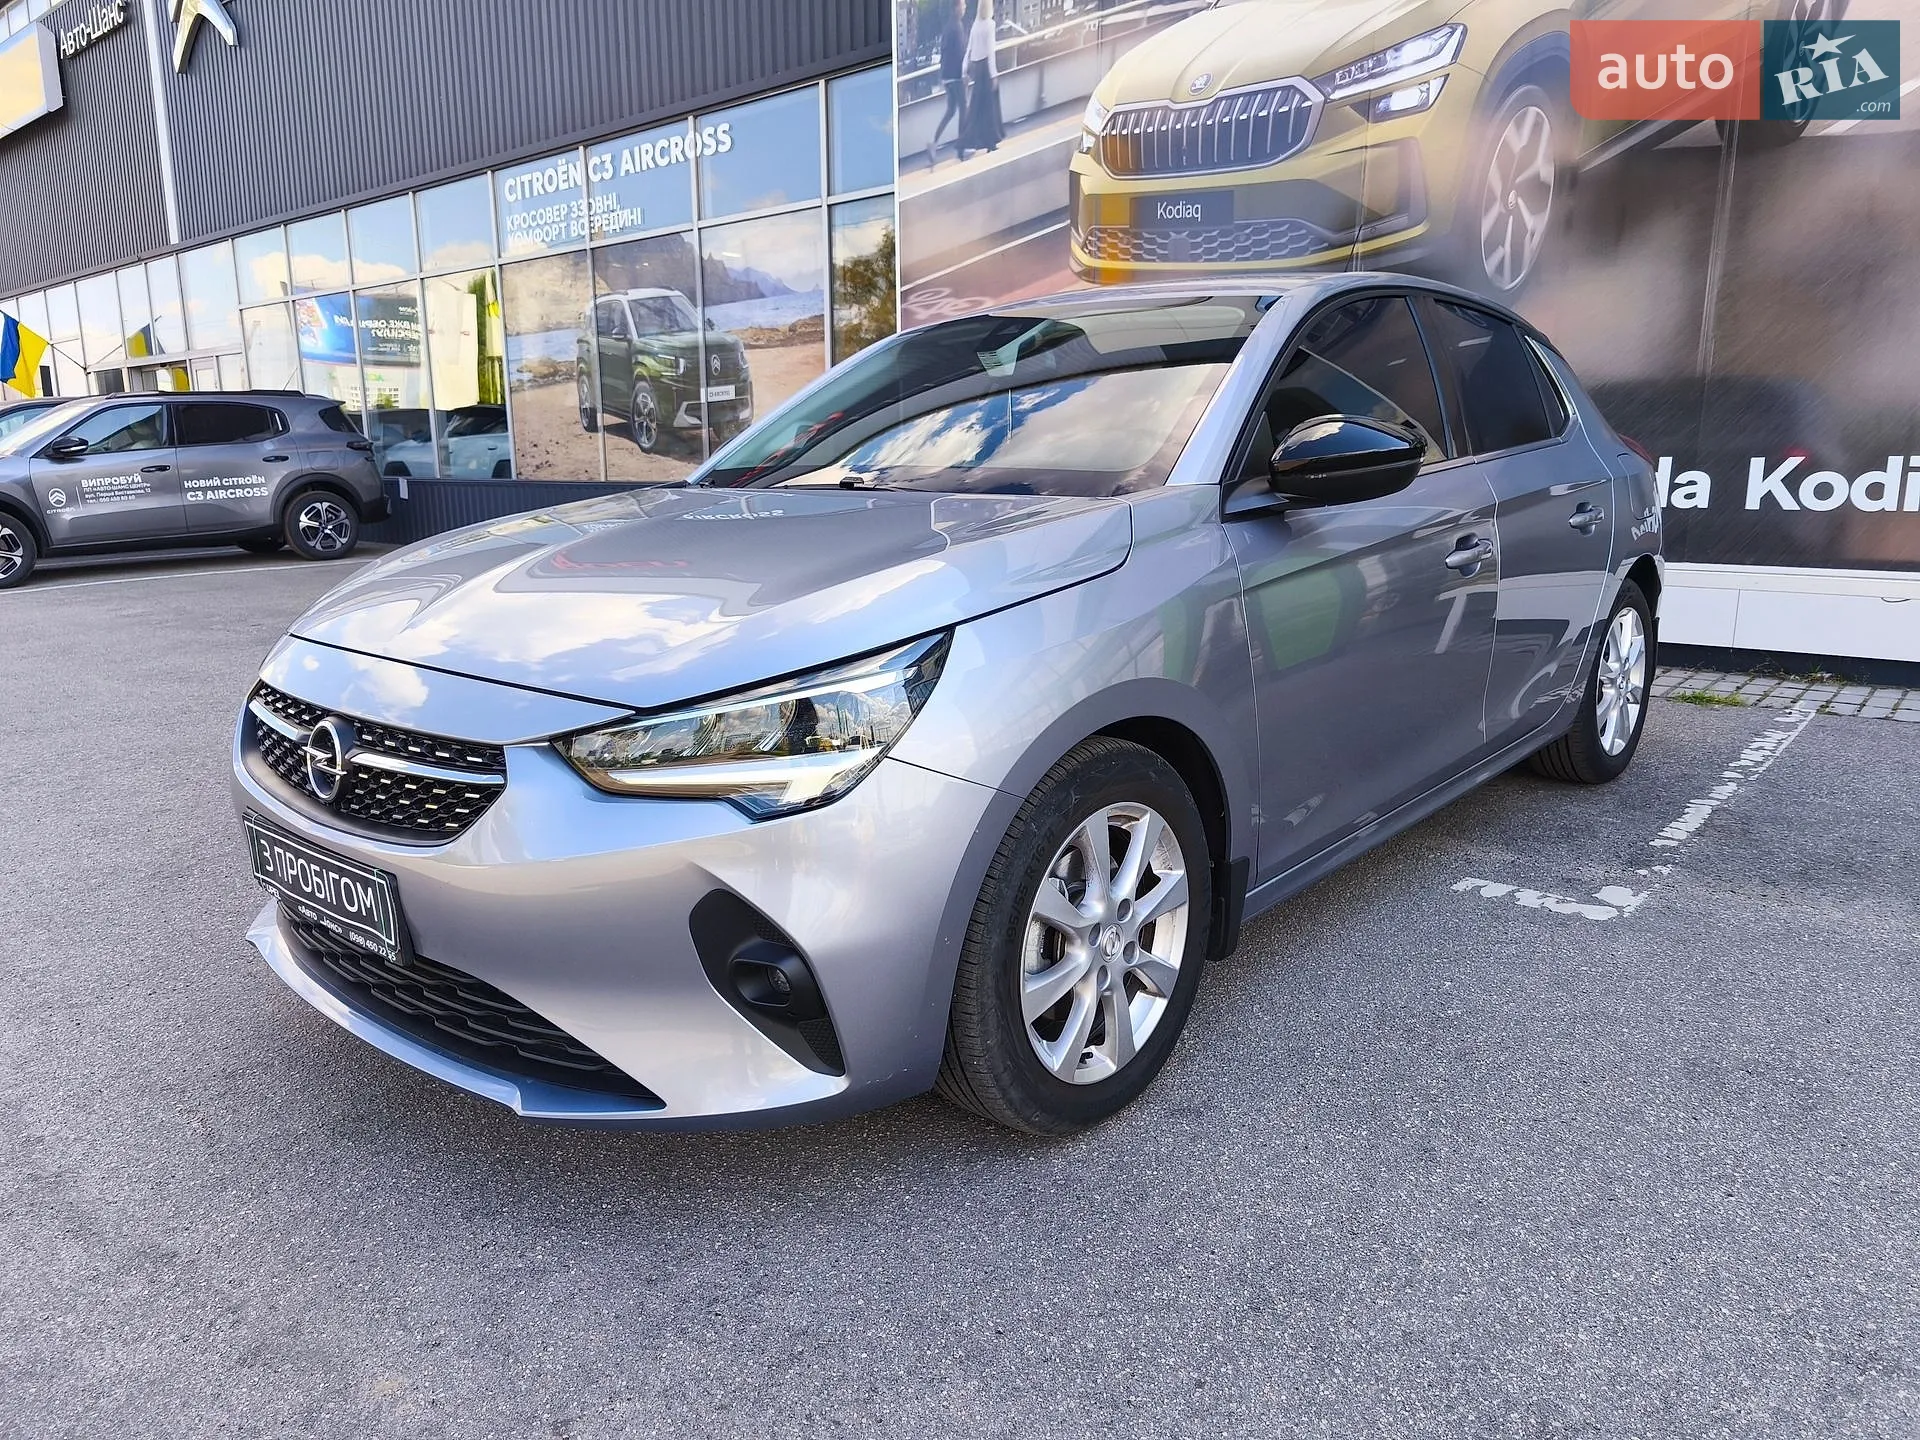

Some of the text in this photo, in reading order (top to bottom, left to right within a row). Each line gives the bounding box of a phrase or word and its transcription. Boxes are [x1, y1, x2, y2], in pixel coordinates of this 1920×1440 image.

[60, 0, 124, 59] Авто-Шанс
[504, 122, 733, 202] CITROËN C3 AIRCROSS
[506, 203, 568, 231] КРОСОВЕР
[1157, 200, 1201, 222] Kodiaq
[507, 222, 567, 244] КОМФОРТ
[81, 473, 142, 488] ВИПРОБУЙ
[184, 474, 266, 488] НОВИЙ CITROËN
[187, 487, 269, 501] C3 AIRCROSS
[260, 839, 378, 922] З ПРОБІГОМ
